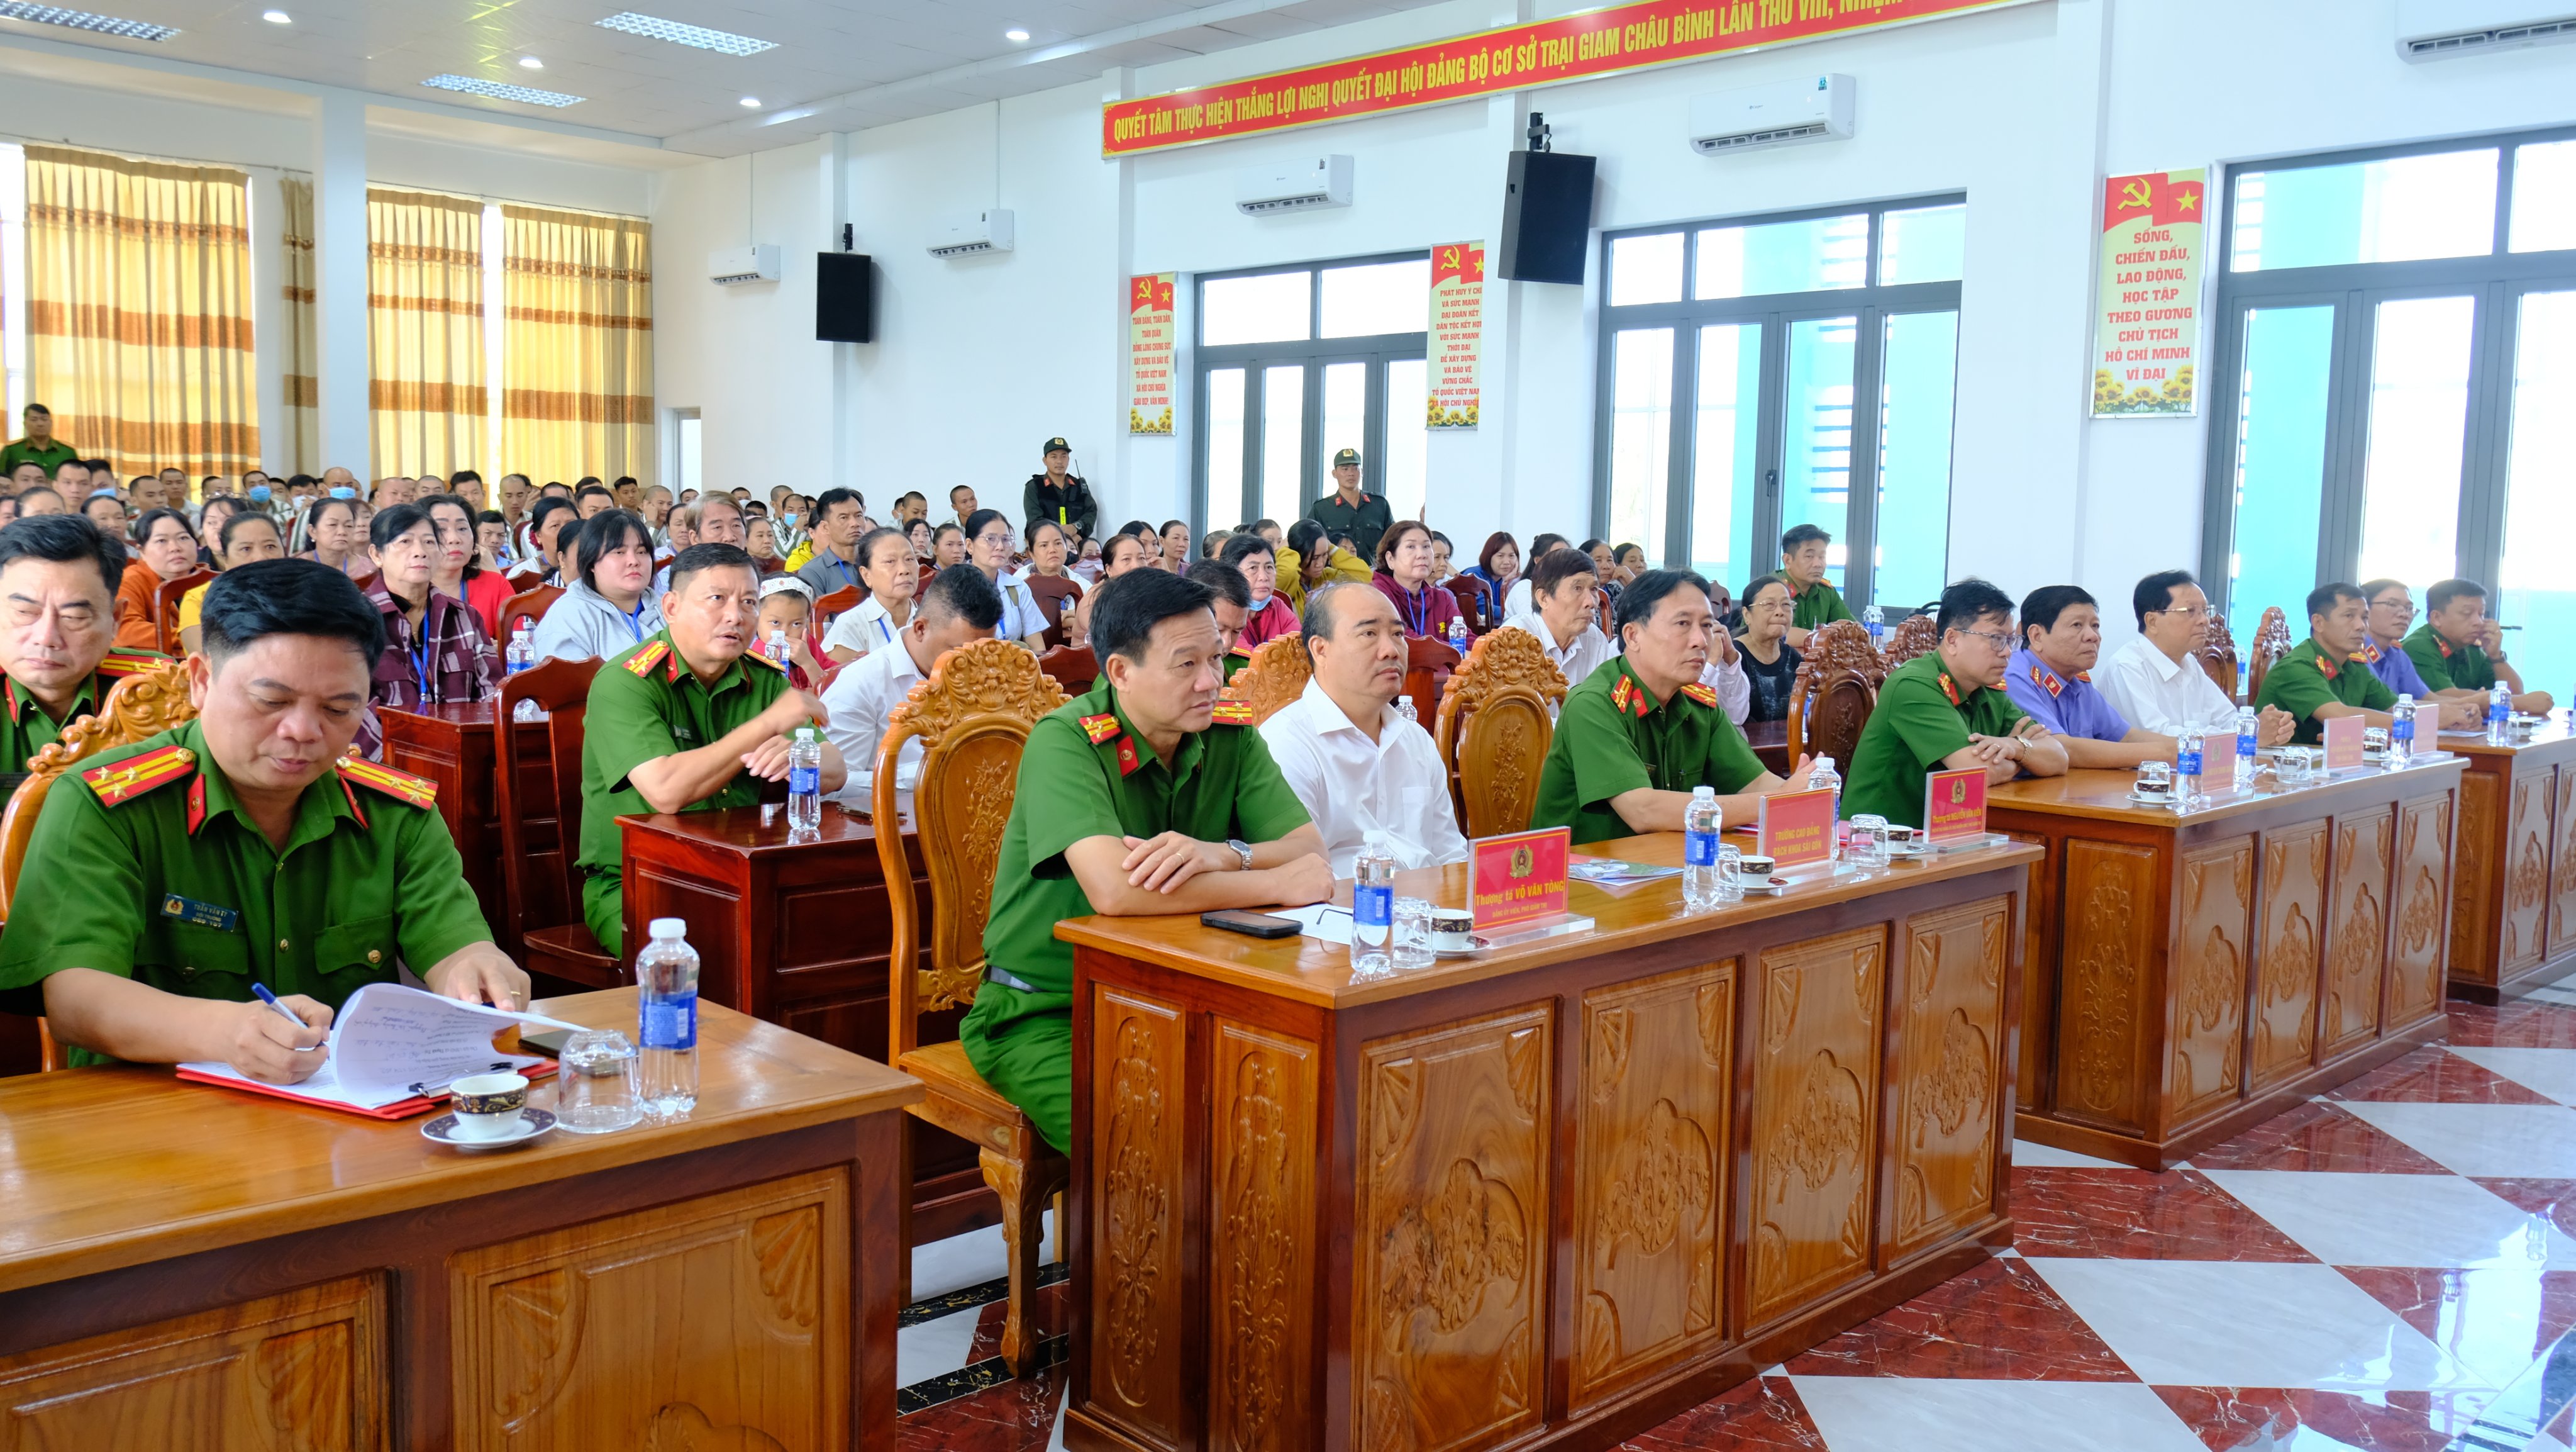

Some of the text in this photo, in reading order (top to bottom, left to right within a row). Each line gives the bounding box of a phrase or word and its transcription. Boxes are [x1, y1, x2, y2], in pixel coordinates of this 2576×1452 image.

[1114, 108, 1146, 143] QUYẾT
[1149, 107, 1172, 135] TÂM
[1175, 103, 1203, 135] THỰC
[1206, 96, 1233, 130] HIỆN
[1236, 86, 1274, 121] THẮNG
[1277, 86, 1296, 119] LỢI
[1299, 82, 1329, 112] NGHỊ
[1332, 67, 1372, 107] QUYẾT
[1375, 70, 1397, 101] ĐẠI
[1401, 60, 1423, 97] HỘI
[1427, 52, 1465, 89] ĐẢNG
[1468, 47, 1489, 85] BỘ
[1492, 45, 1513, 77] CƠ
[1516, 35, 1537, 72] SỞ
[1541, 36, 1574, 70] TRẠI
[1579, 27, 1620, 61] GIAM
[1624, 14, 1669, 53] CHÂU
[1673, 8, 1715, 45] BÌNH
[2133, 226, 2174, 244] SỐNG,
[2115, 246, 2190, 265] CHIẾN ĐẤU,
[2116, 268, 2187, 284] LAO ĐỘNG,
[1440, 288, 1454, 296] PHÁT
[2122, 287, 2179, 304] HỌC TẬP
[1450, 299, 1461, 307] SỨC
[1462, 299, 1479, 307] MẠNH
[1468, 307, 1479, 317] KẾT
[2107, 307, 2192, 324] THEO GƯƠNG
[1449, 321, 1460, 330] TỘC
[1460, 320, 1471, 328] KẾT
[1462, 332, 1479, 340] MẠNH
[2118, 327, 2179, 343] CHỦ TỊCH
[2104, 346, 2190, 362] HỒ CHÍ MINH
[2126, 367, 2166, 382] VĨ ĐẠI
[1440, 387, 1454, 396] QUỐC
[1455, 388, 1468, 396] VIỆT
[1475, 880, 1564, 907] Thượng tá VÕ VĂN TÒNG
